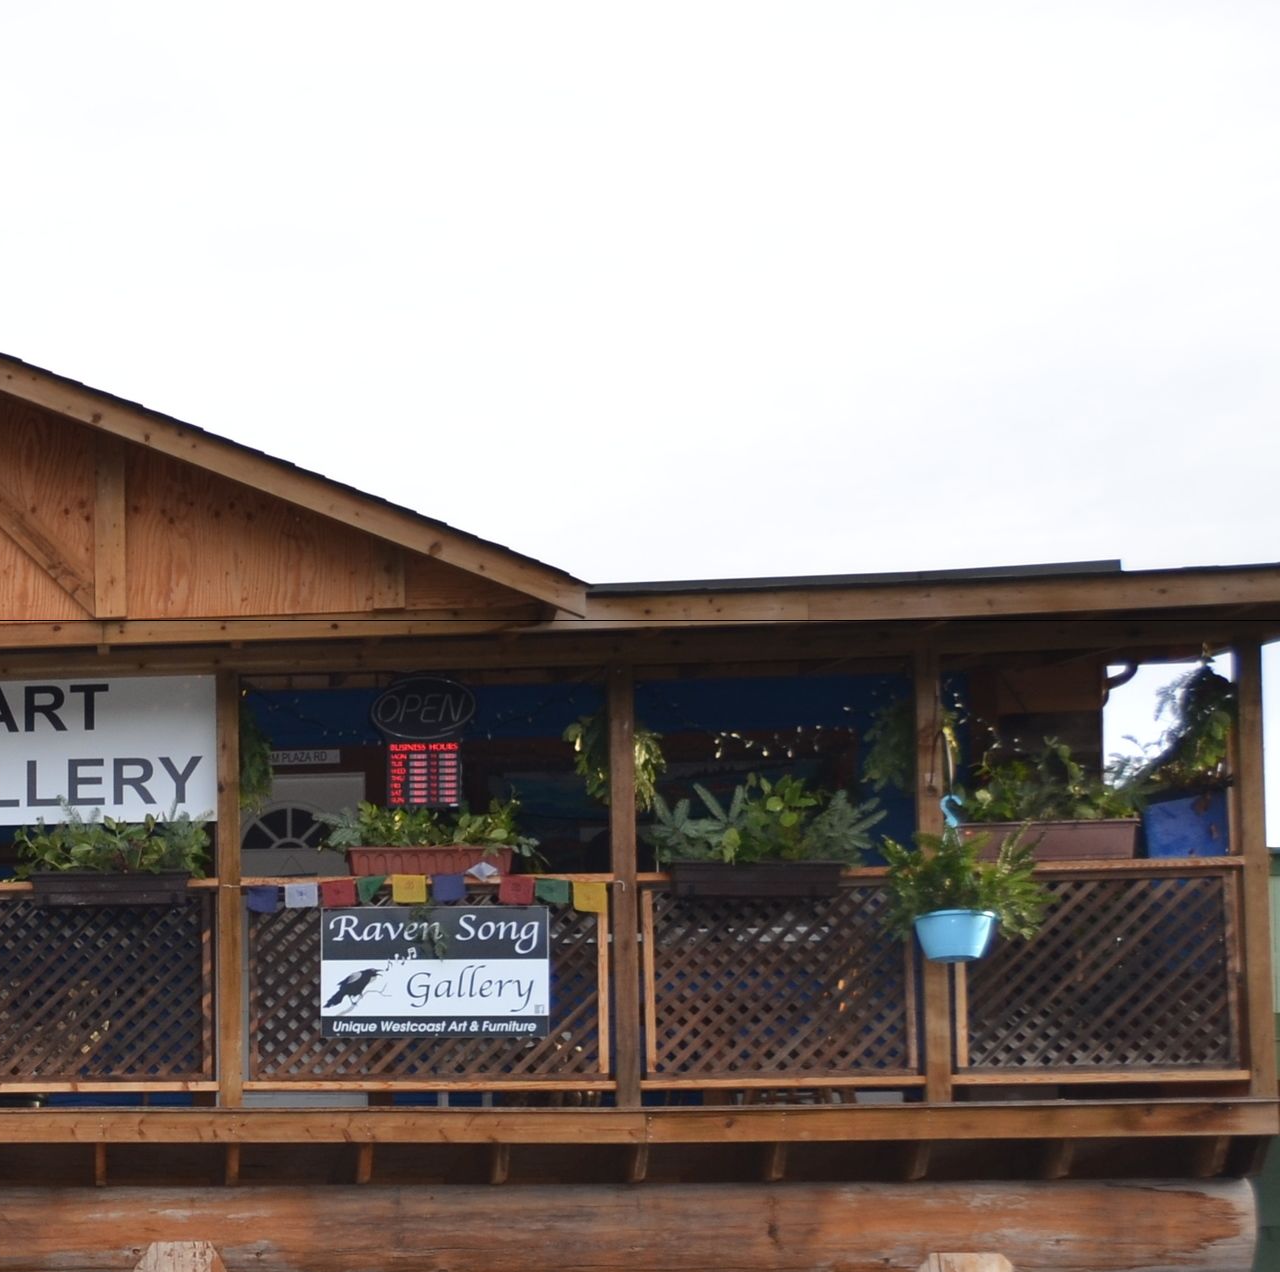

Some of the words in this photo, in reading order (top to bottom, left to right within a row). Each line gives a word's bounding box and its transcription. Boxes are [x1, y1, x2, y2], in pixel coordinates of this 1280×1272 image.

[377, 693, 465, 723] OPEN
[329, 915, 443, 942] Raven
[455, 914, 540, 955] Song
[406, 965, 534, 1012] Gallery
[332, 1021, 378, 1037] Unique
[380, 1021, 446, 1033] Westcoast
[447, 1021, 468, 1033] Art
[469, 1021, 479, 1033] &
[481, 1021, 537, 1033] Furniture
